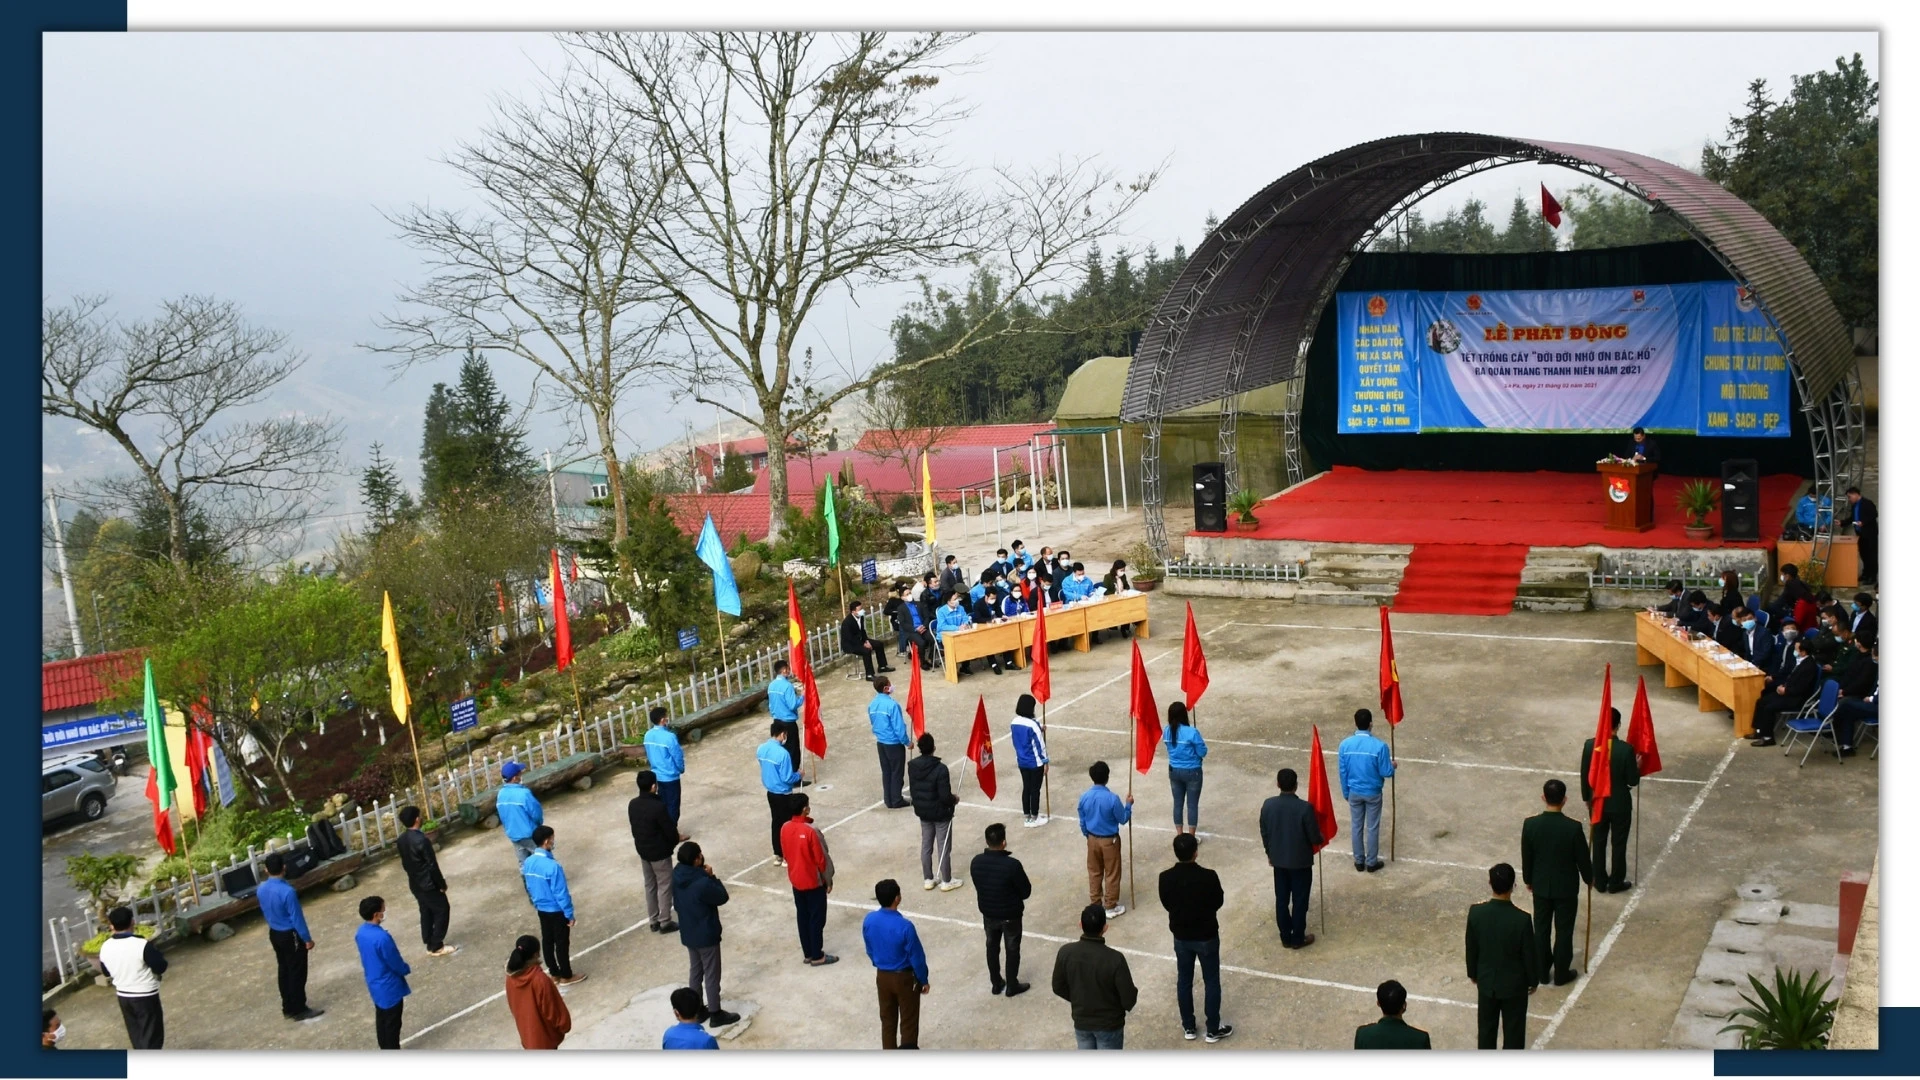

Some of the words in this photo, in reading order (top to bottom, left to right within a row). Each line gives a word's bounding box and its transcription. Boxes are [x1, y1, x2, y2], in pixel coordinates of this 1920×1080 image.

[1512, 323, 1565, 342] PHÁT
[1569, 321, 1628, 343] ĐỘNG
[1390, 336, 1404, 347] TỘC
[1356, 351, 1368, 362] THỊ
[1381, 351, 1391, 360] SA
[1393, 351, 1404, 360] PA
[1511, 350, 1529, 362] CÂY
[1555, 351, 1572, 362] ĐỜI
[1574, 350, 1595, 362] NHỚ
[1597, 350, 1612, 361] ƠN
[1614, 349, 1634, 361] BÁC
[1384, 363, 1401, 373] TÂM
[1704, 355, 1730, 371] CHUNG
[1732, 355, 1745, 371] TAY
[1746, 352, 1761, 371] XÂY
[1763, 354, 1786, 375] DỰNG
[1474, 366, 1486, 376] RA
[1488, 366, 1511, 376] QUÂN
[1513, 366, 1541, 376] THÁNG
[1543, 366, 1571, 376] THANH
[1573, 365, 1595, 375] NIÊN
[1597, 365, 1618, 375] NĂM
[1620, 365, 1641, 375] 2021
[1360, 376, 1375, 387] XÂY
[1377, 377, 1398, 388] DỰNG
[1386, 390, 1404, 402] HIỆU
[1352, 404, 1362, 413] SA
[1364, 404, 1374, 413] PA
[1393, 404, 1405, 415] THỊ
[1707, 411, 1728, 428] XANH
[1735, 412, 1757, 432] SẠCH
[1763, 413, 1780, 432] ĐẸP
